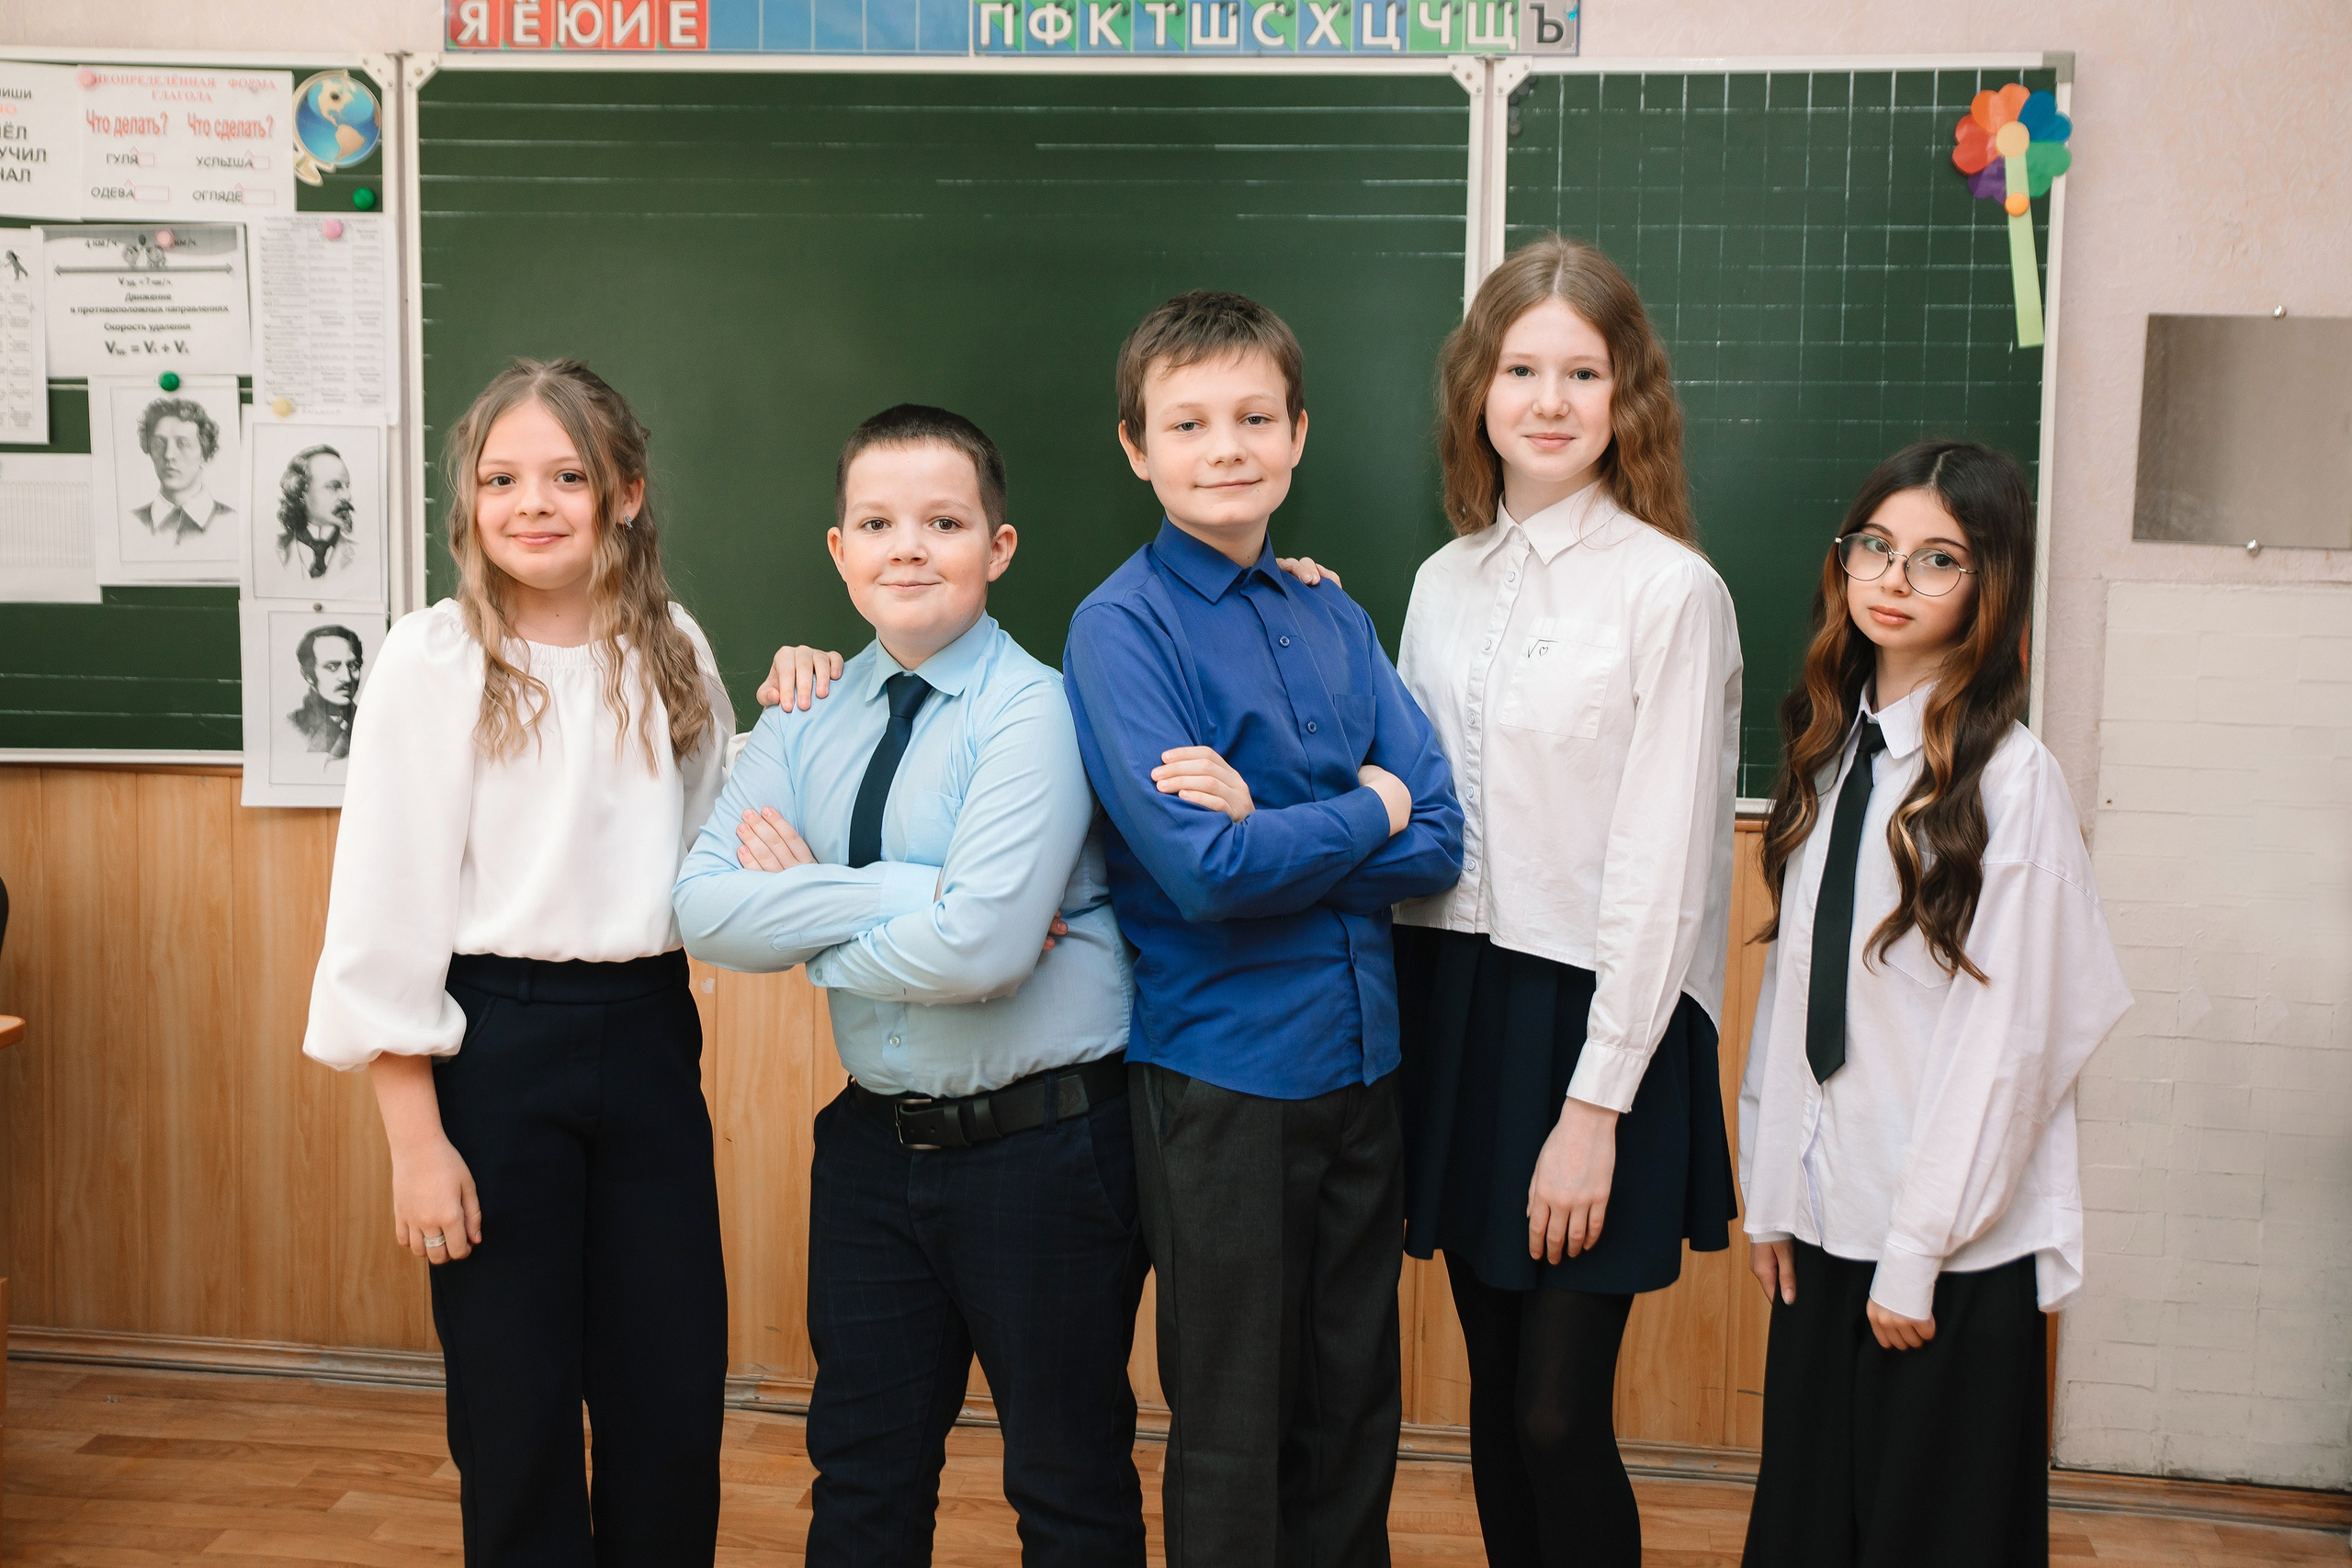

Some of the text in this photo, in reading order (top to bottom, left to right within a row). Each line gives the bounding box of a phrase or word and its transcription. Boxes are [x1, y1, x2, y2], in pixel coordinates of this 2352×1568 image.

[0, 121, 27, 140] ЁЛ
[86, 108, 169, 138] Что делать?
[187, 111, 274, 141] Что сделать?
[106, 152, 139, 165] ГУЛЯ
[196, 155, 254, 170] УСЛЫША
[91, 186, 135, 199] ОДЕВА
[192, 189, 243, 204] ОГЛЯДЕ
[104, 322, 147, 333] Скорость
